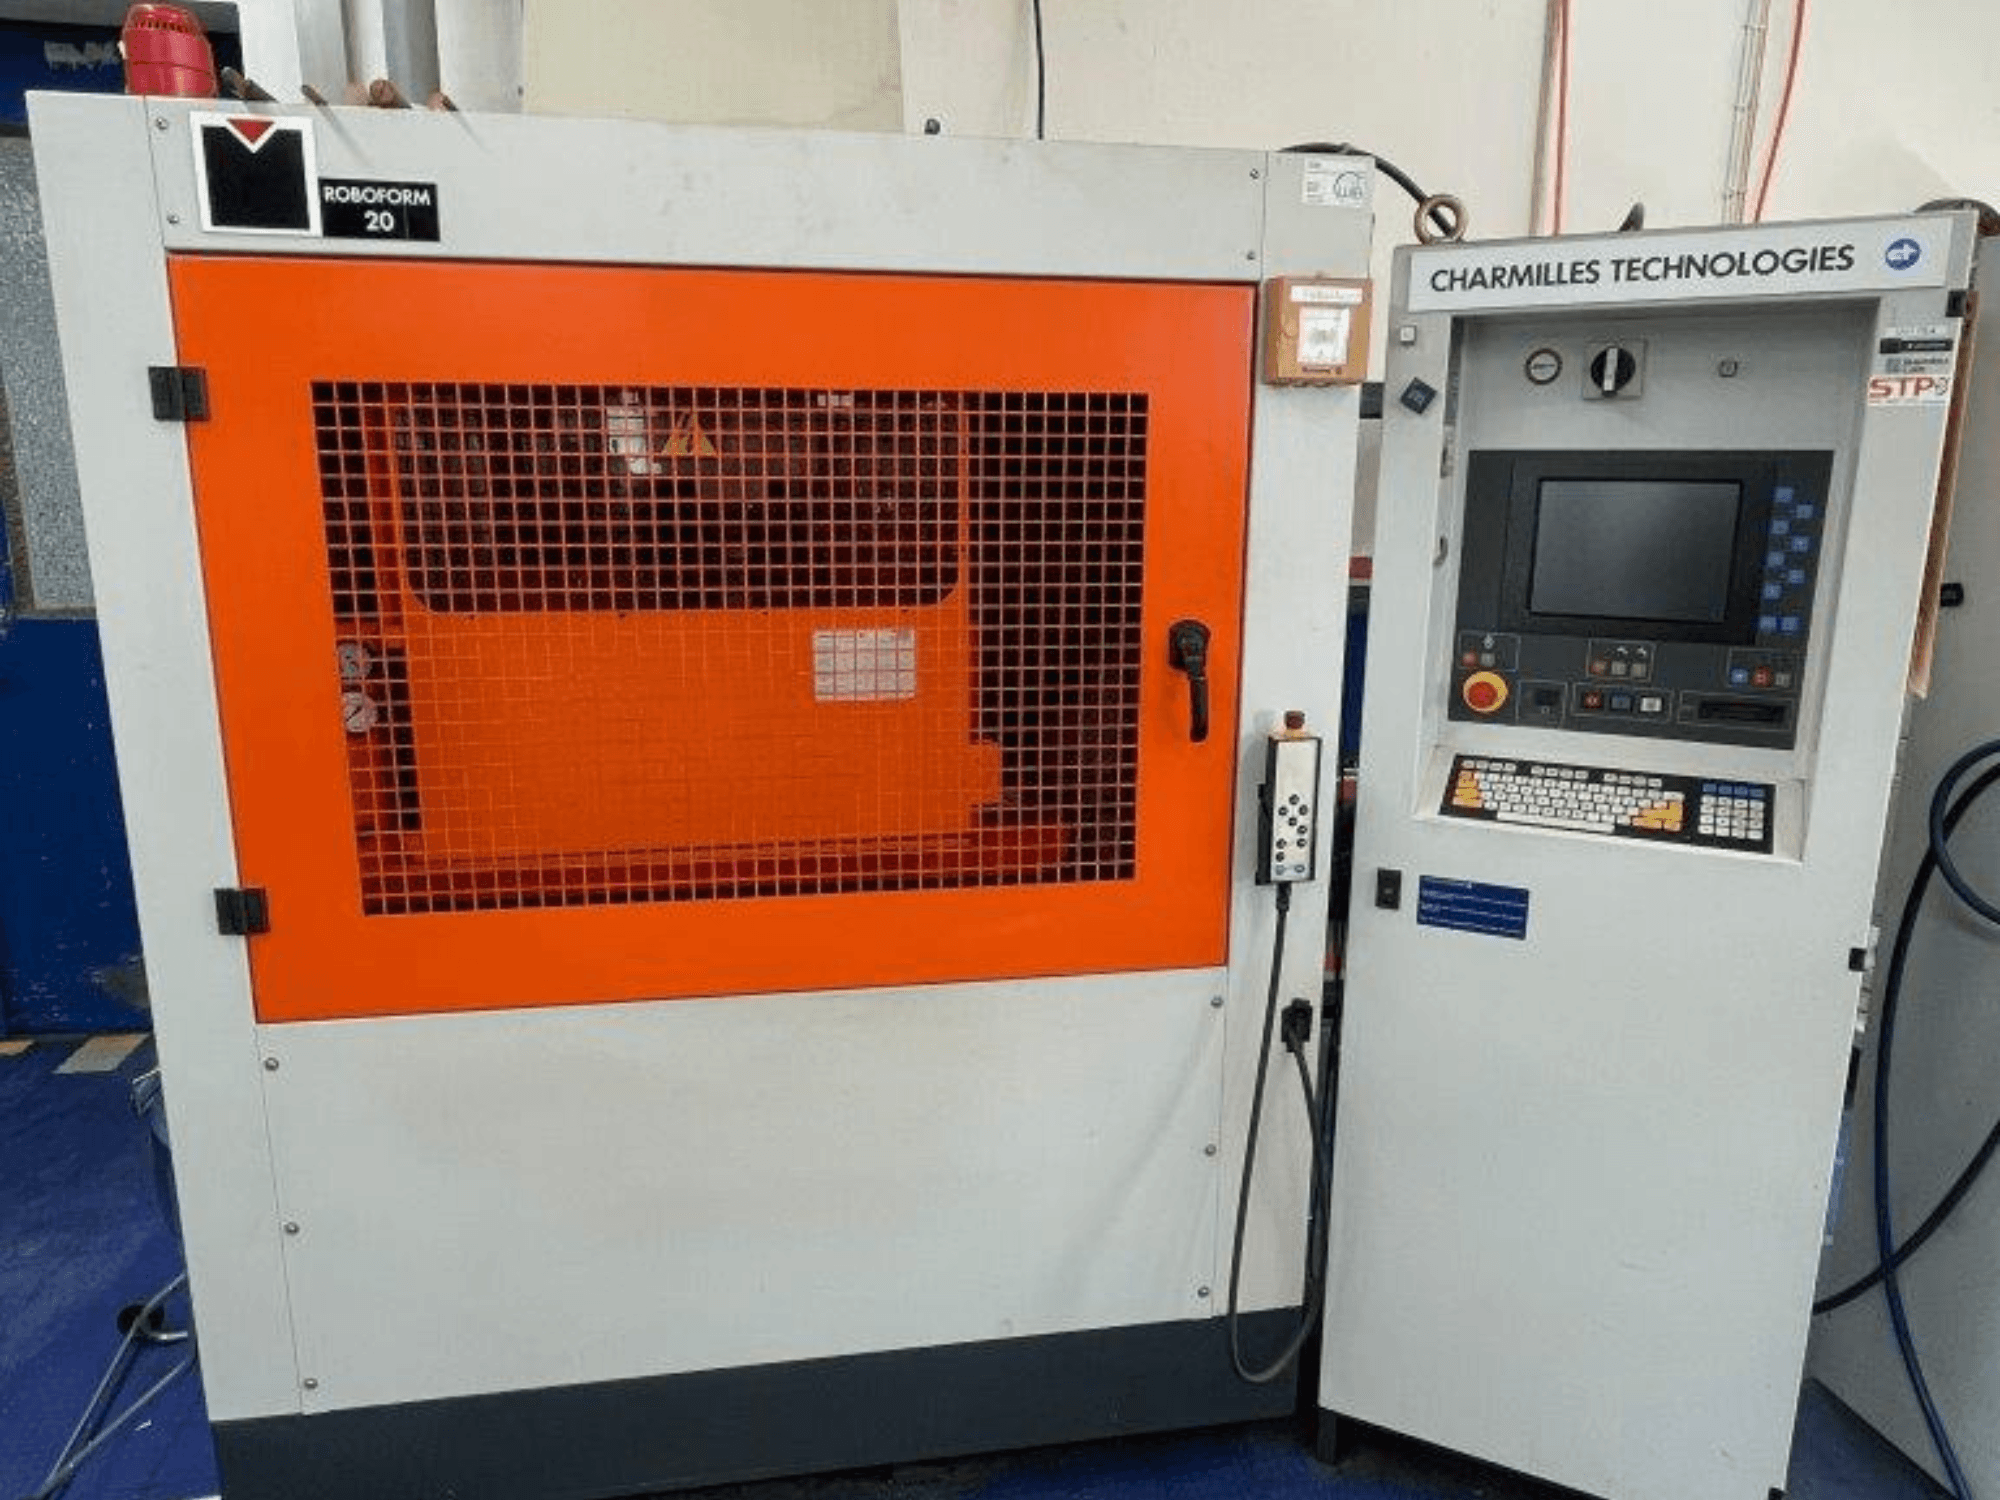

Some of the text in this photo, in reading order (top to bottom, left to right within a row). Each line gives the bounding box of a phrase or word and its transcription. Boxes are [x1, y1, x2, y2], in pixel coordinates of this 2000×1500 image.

[323, 186, 430, 206] ROBOFORM
[363, 209, 395, 232] 20
[1430, 244, 1856, 292] CHARMILLES TECHNOLOGIES
